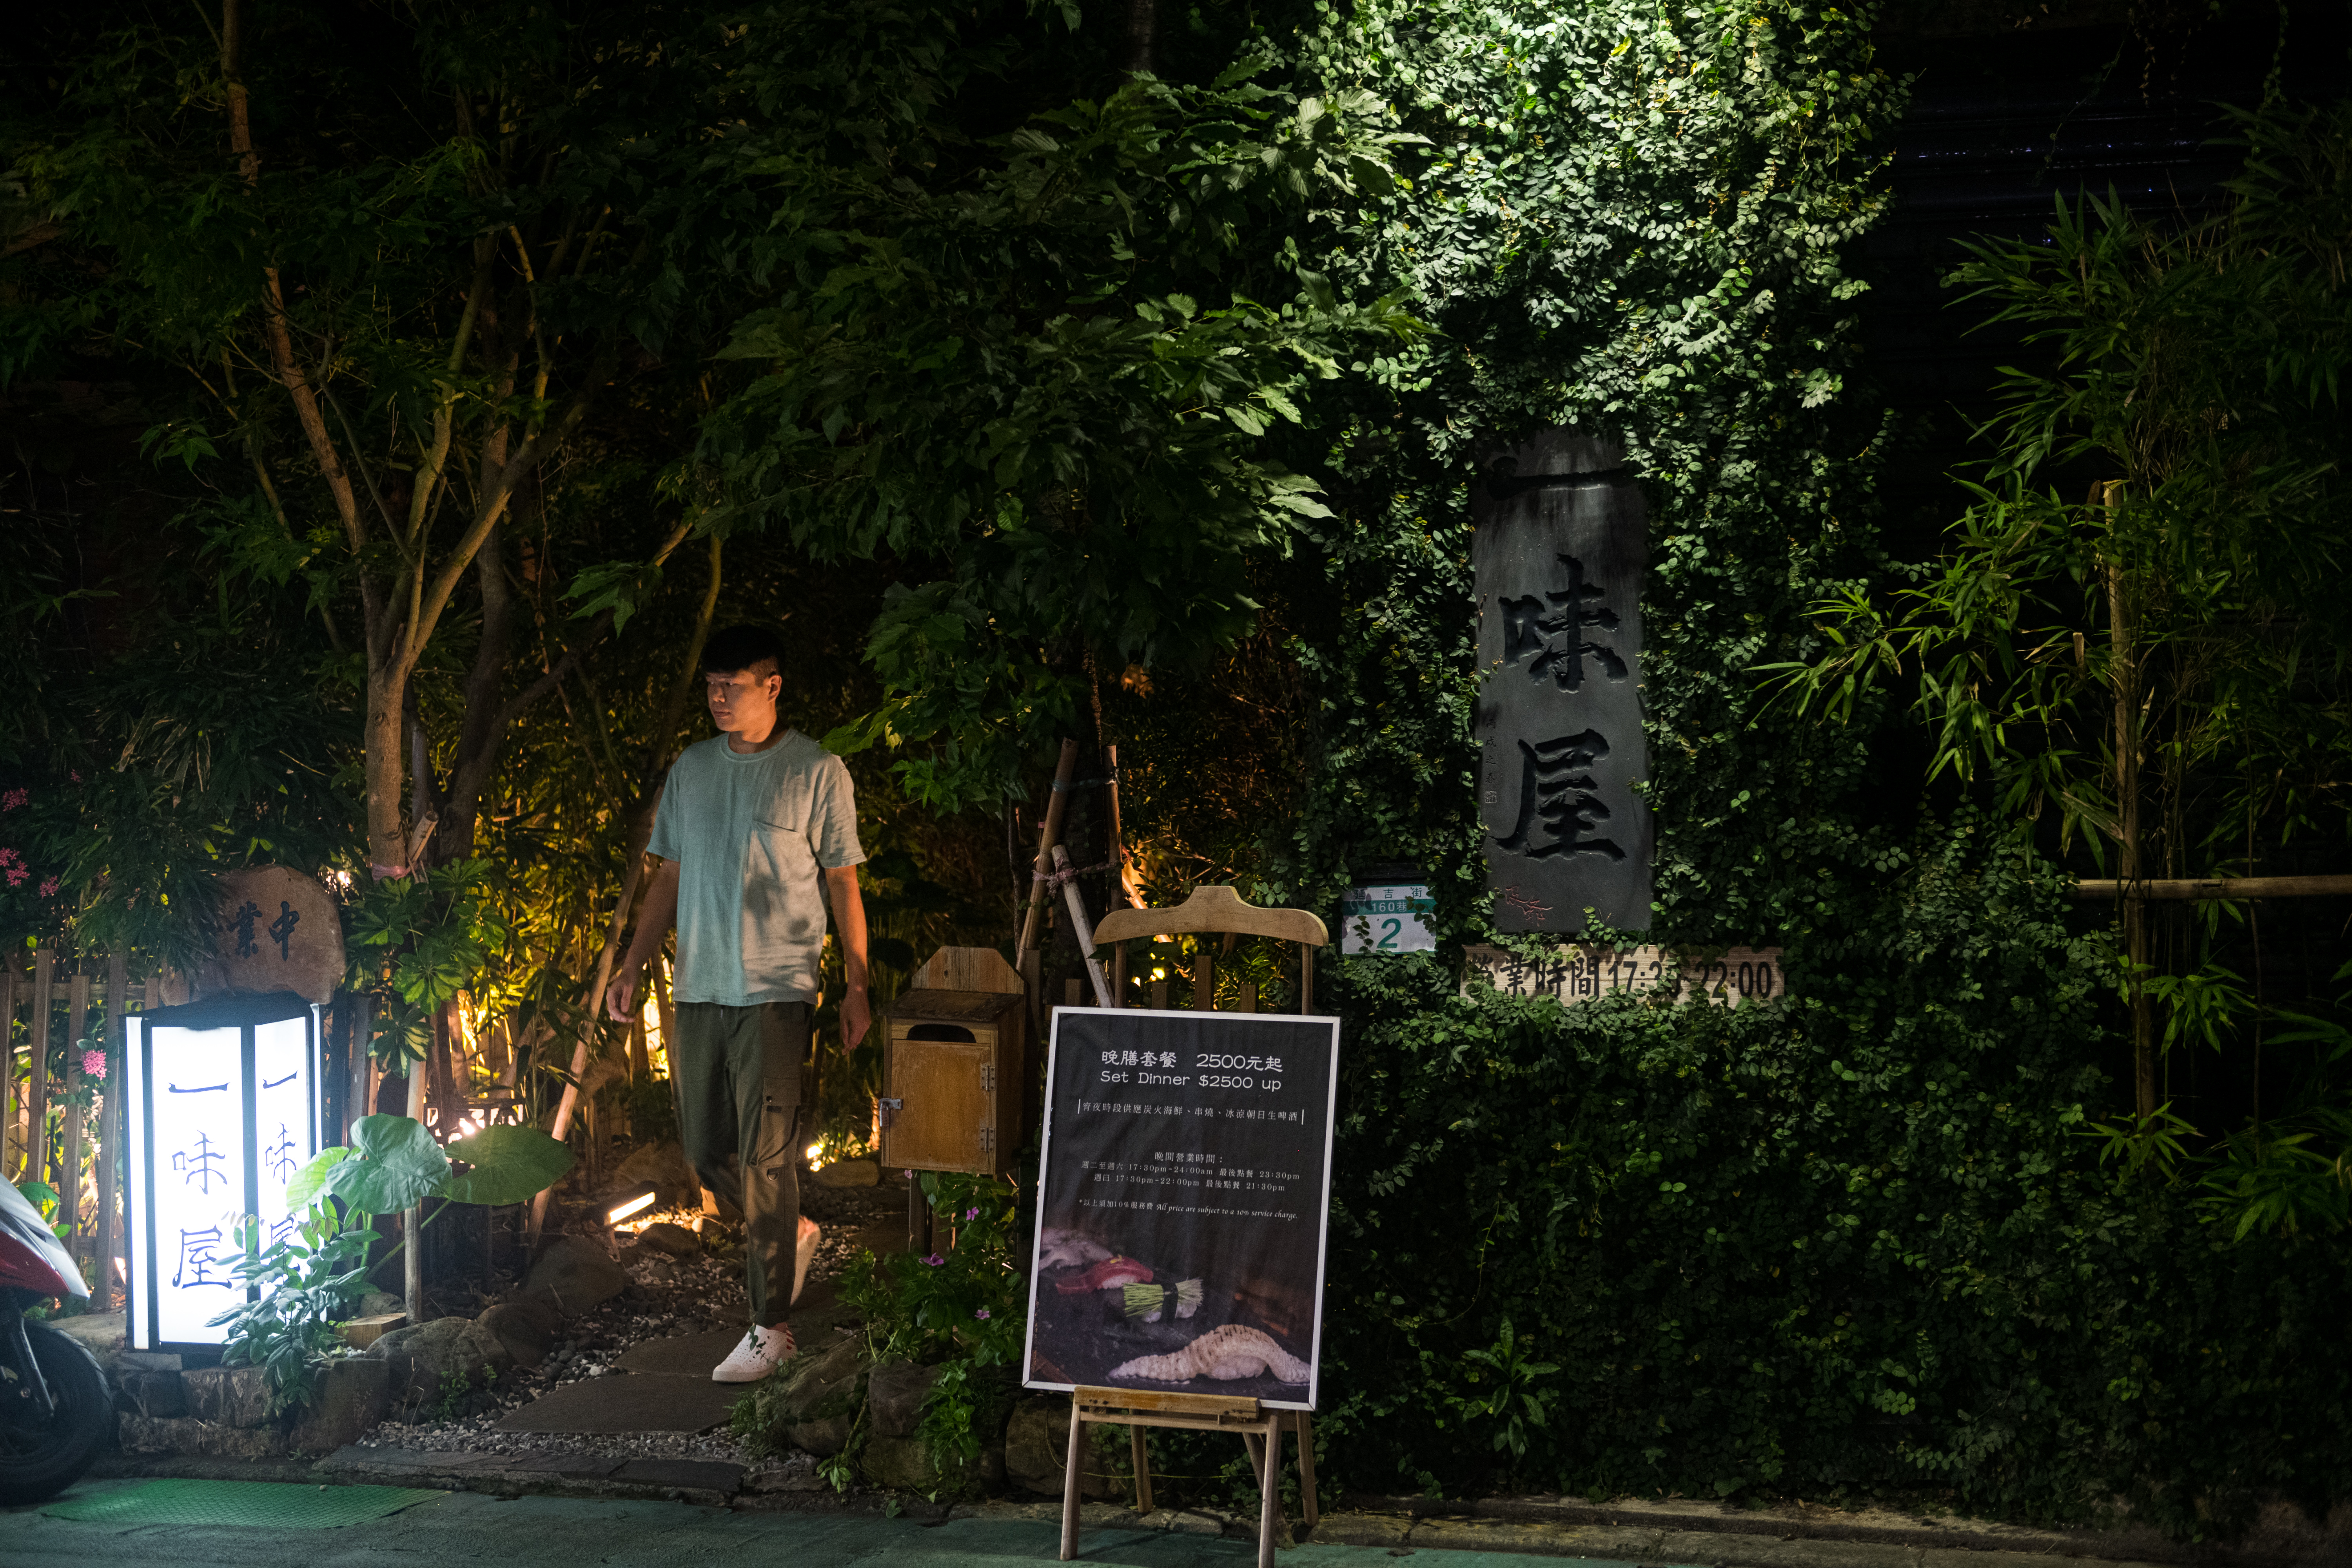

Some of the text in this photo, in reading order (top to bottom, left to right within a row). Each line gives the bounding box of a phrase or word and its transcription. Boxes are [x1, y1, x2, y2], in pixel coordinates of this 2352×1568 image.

[1355, 887, 1422, 900] 延吉街
[1372, 902, 1407, 912] 160巷
[214, 901, 300, 961] 業中
[1377, 918, 1401, 949] 2
[1102, 1050, 1283, 1073] 晚膳套餐 2500元起
[1100, 1071, 1281, 1092] Set Dinner $2500 up
[1081, 1160, 1123, 1170] 週二至週六
[1220, 1168, 1253, 1178] 最後點餐
[1259, 1171, 1299, 1181] 23:30pm
[169, 1082, 234, 1290] 一味屋
[1094, 1173, 1110, 1182] 週日
[1206, 1180, 1240, 1189] 最後點餐
[1246, 1182, 1285, 1192] 21:30pm
[1156, 1203, 1168, 1211] All
[1162, 1205, 1184, 1214] price
[1198, 1205, 1220, 1216] subject
[1274, 1209, 1298, 1221] charge.
